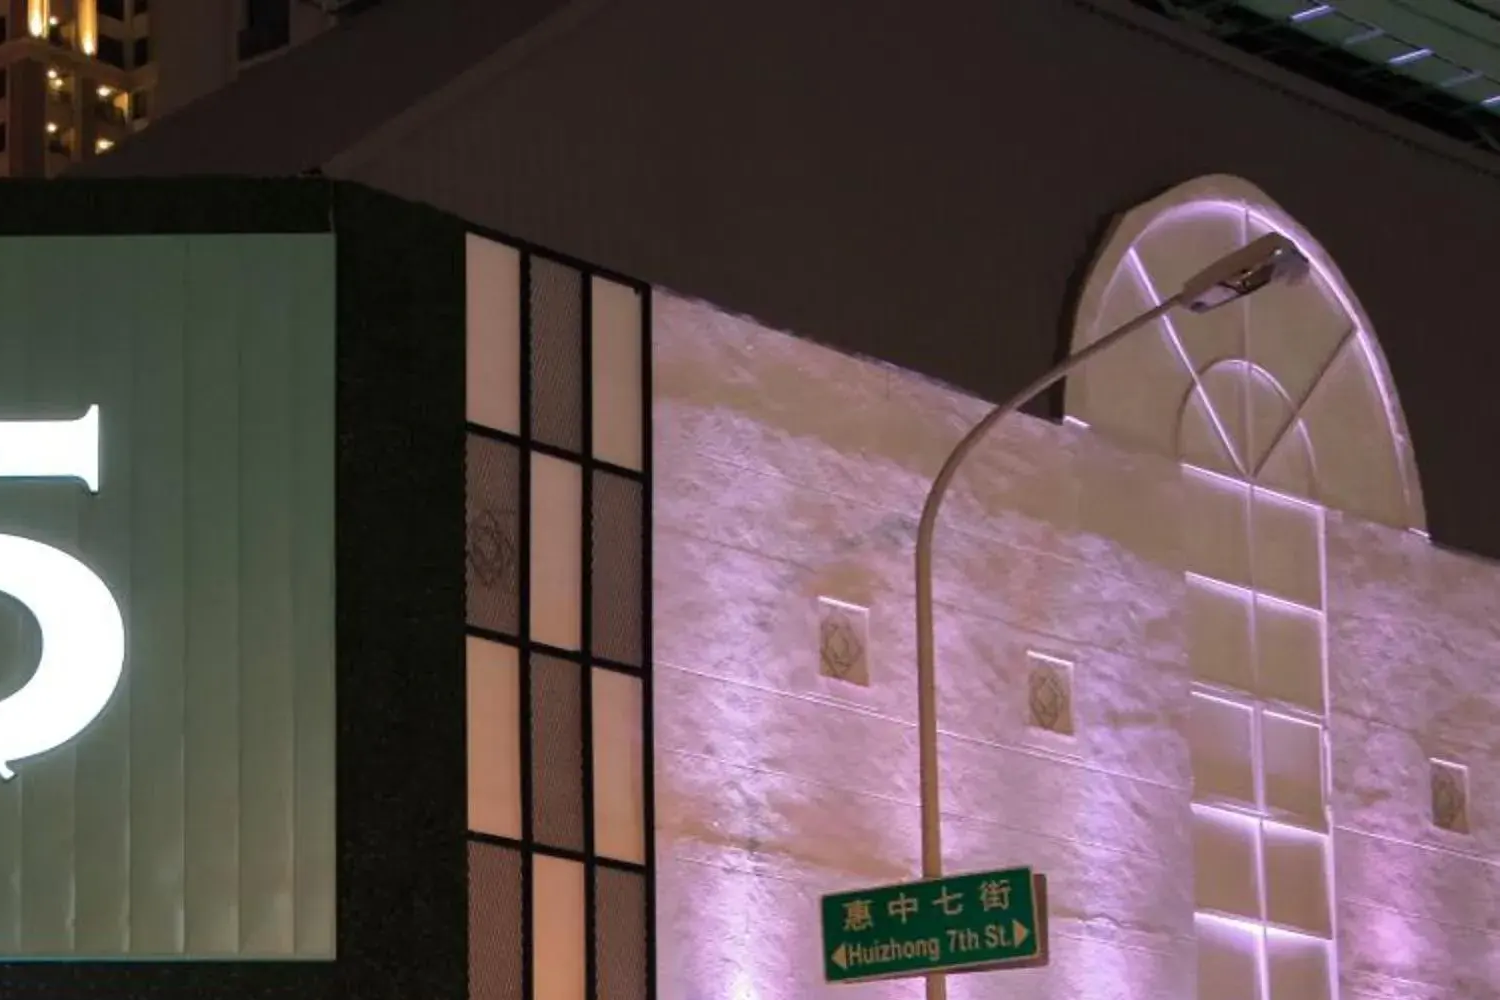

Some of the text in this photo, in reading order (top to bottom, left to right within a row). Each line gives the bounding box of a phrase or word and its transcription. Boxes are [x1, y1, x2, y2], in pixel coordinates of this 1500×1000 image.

[842, 879, 1011, 931] 惠中七街
[850, 937, 940, 966] Huizhong
[946, 926, 979, 953] 7th
